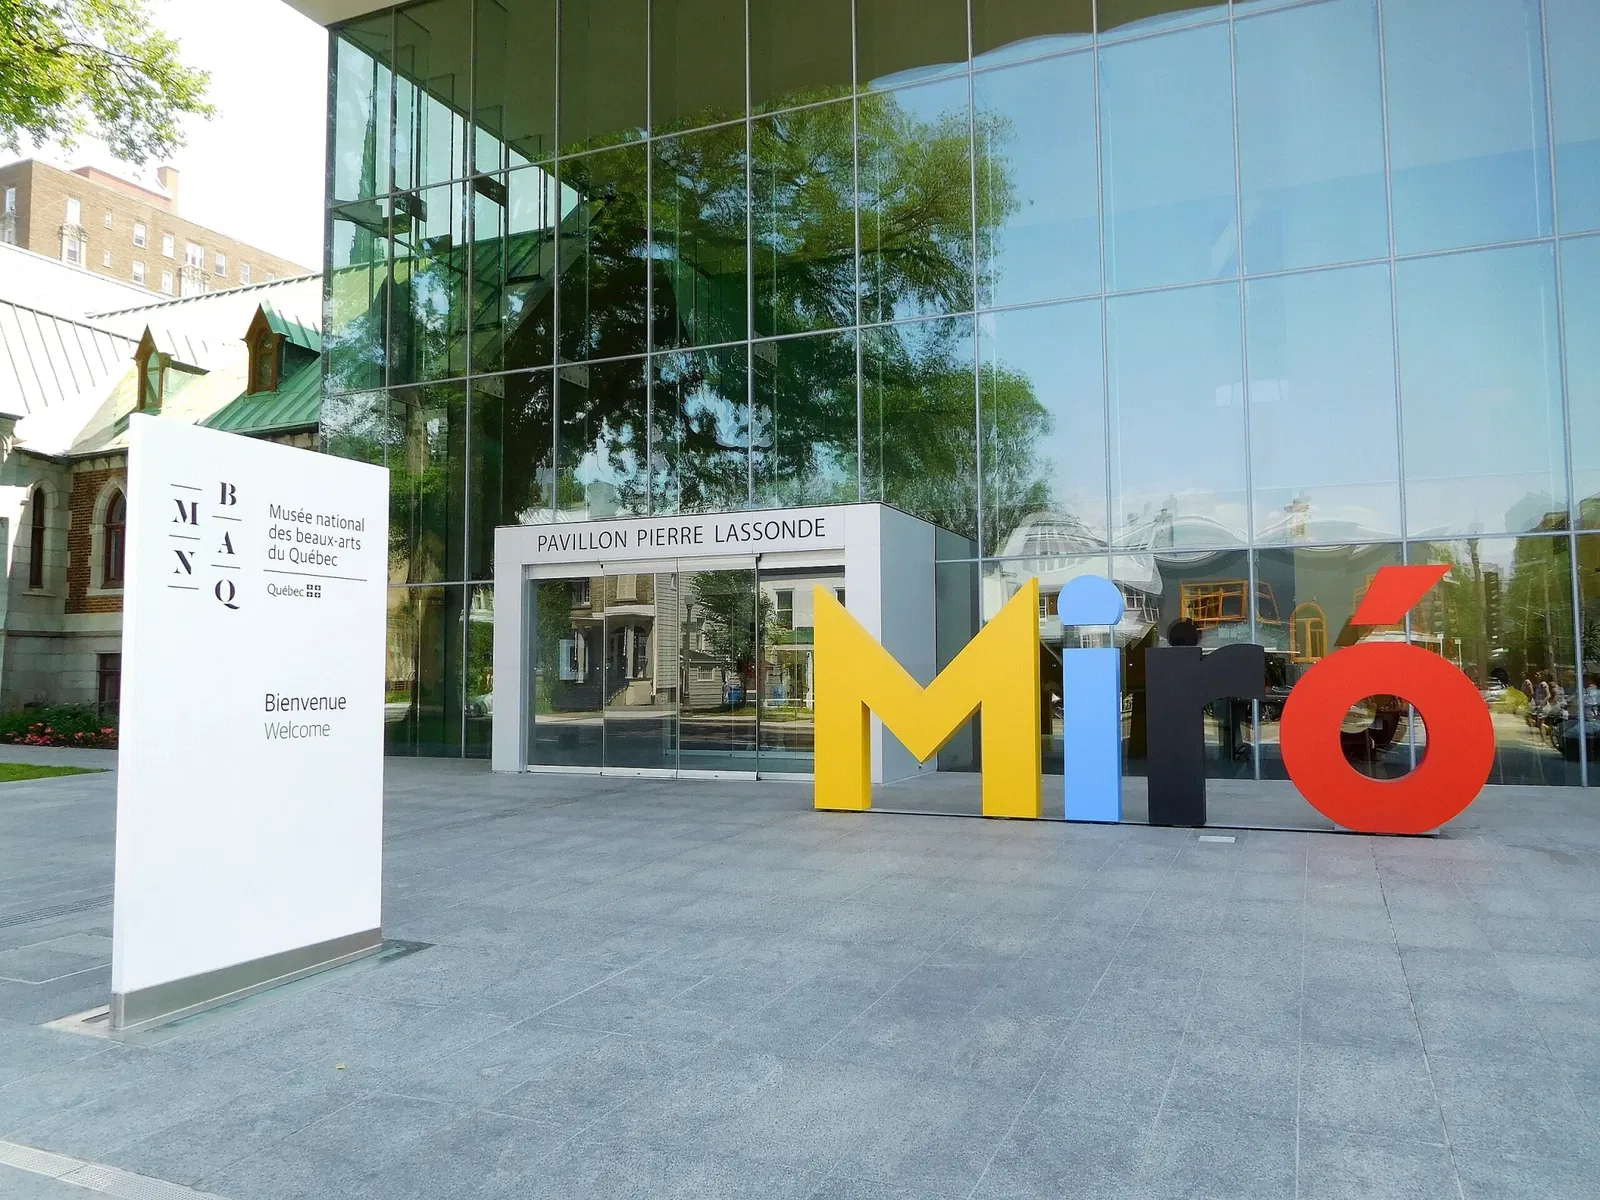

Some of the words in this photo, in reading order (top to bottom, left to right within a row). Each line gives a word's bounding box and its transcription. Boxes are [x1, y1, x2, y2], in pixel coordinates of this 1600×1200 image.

[269, 503, 313, 524] Musée
[316, 511, 365, 532] national
[268, 524, 292, 542] des
[296, 528, 361, 551] beaux-arts
[537, 530, 627, 552] PAVILLON
[637, 525, 704, 547] PIERRE
[715, 517, 826, 543] LASSONDE
[268, 545, 285, 561] du
[289, 547, 338, 567] Québec
[267, 583, 304, 598] Québec
[265, 692, 347, 712] Bienvenue
[813, 563, 1496, 835] Miró
[264, 720, 331, 740] Welcome
